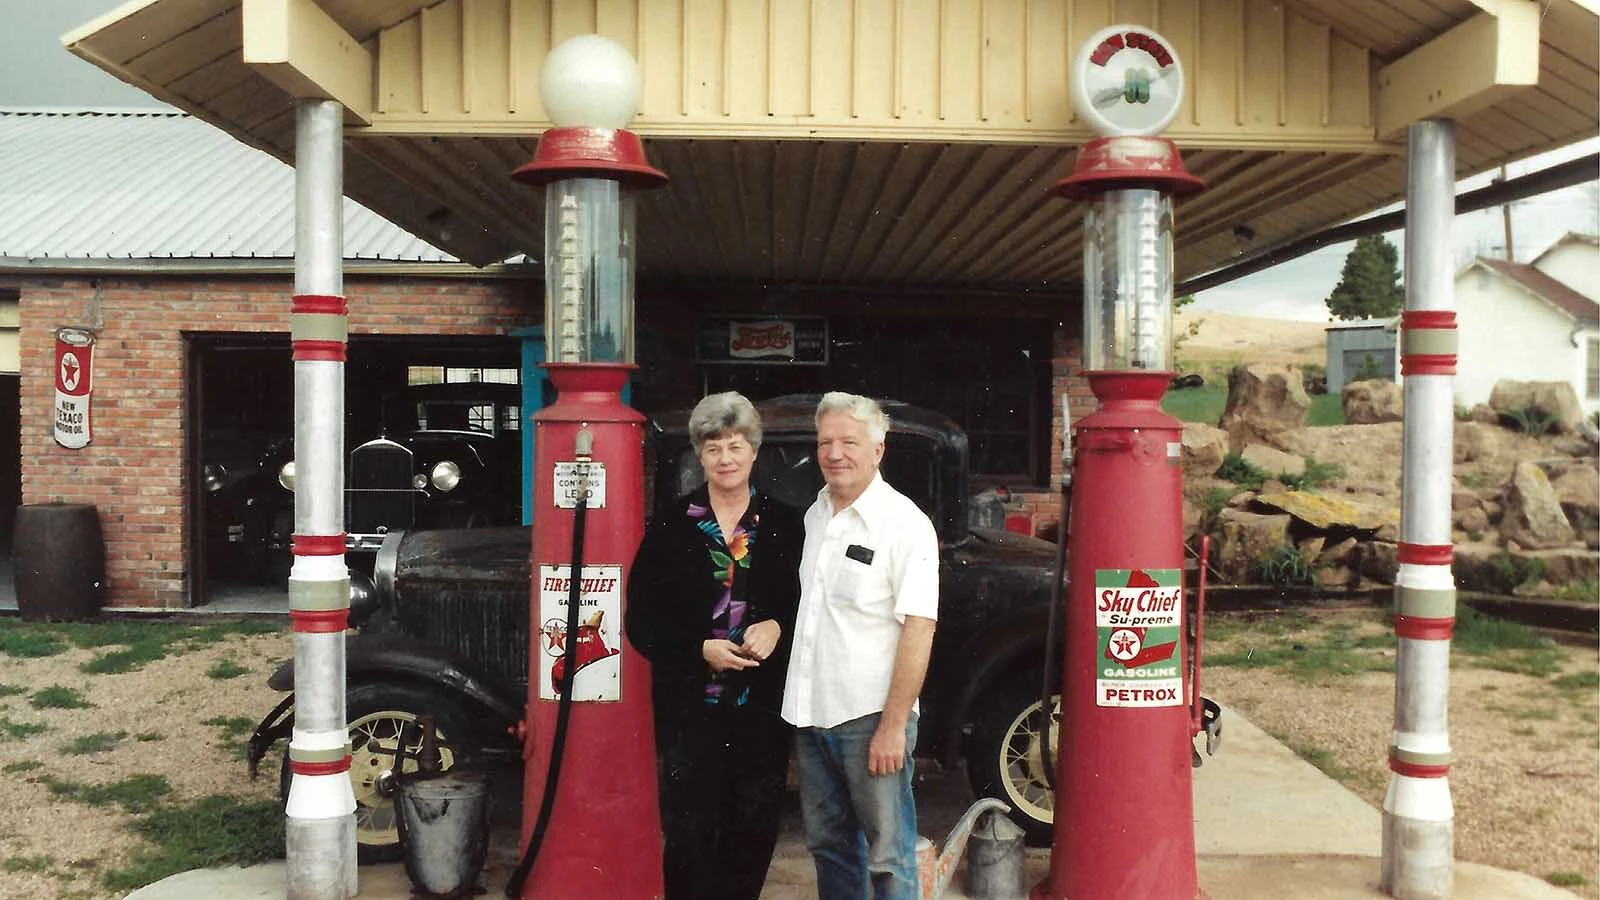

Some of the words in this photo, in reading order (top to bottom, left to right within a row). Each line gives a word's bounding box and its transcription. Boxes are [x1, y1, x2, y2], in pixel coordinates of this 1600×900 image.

[62, 401, 75, 411] NEW
[56, 407, 83, 424] TEXACO
[558, 479, 600, 487] CONNS
[564, 489, 593, 499] LED
[543, 577, 571, 592] FIRE
[1098, 589, 1135, 616] Sky
[1137, 589, 1180, 612] Chief
[1103, 667, 1177, 678] GASOLINE
[1105, 688, 1177, 702] PETROX
